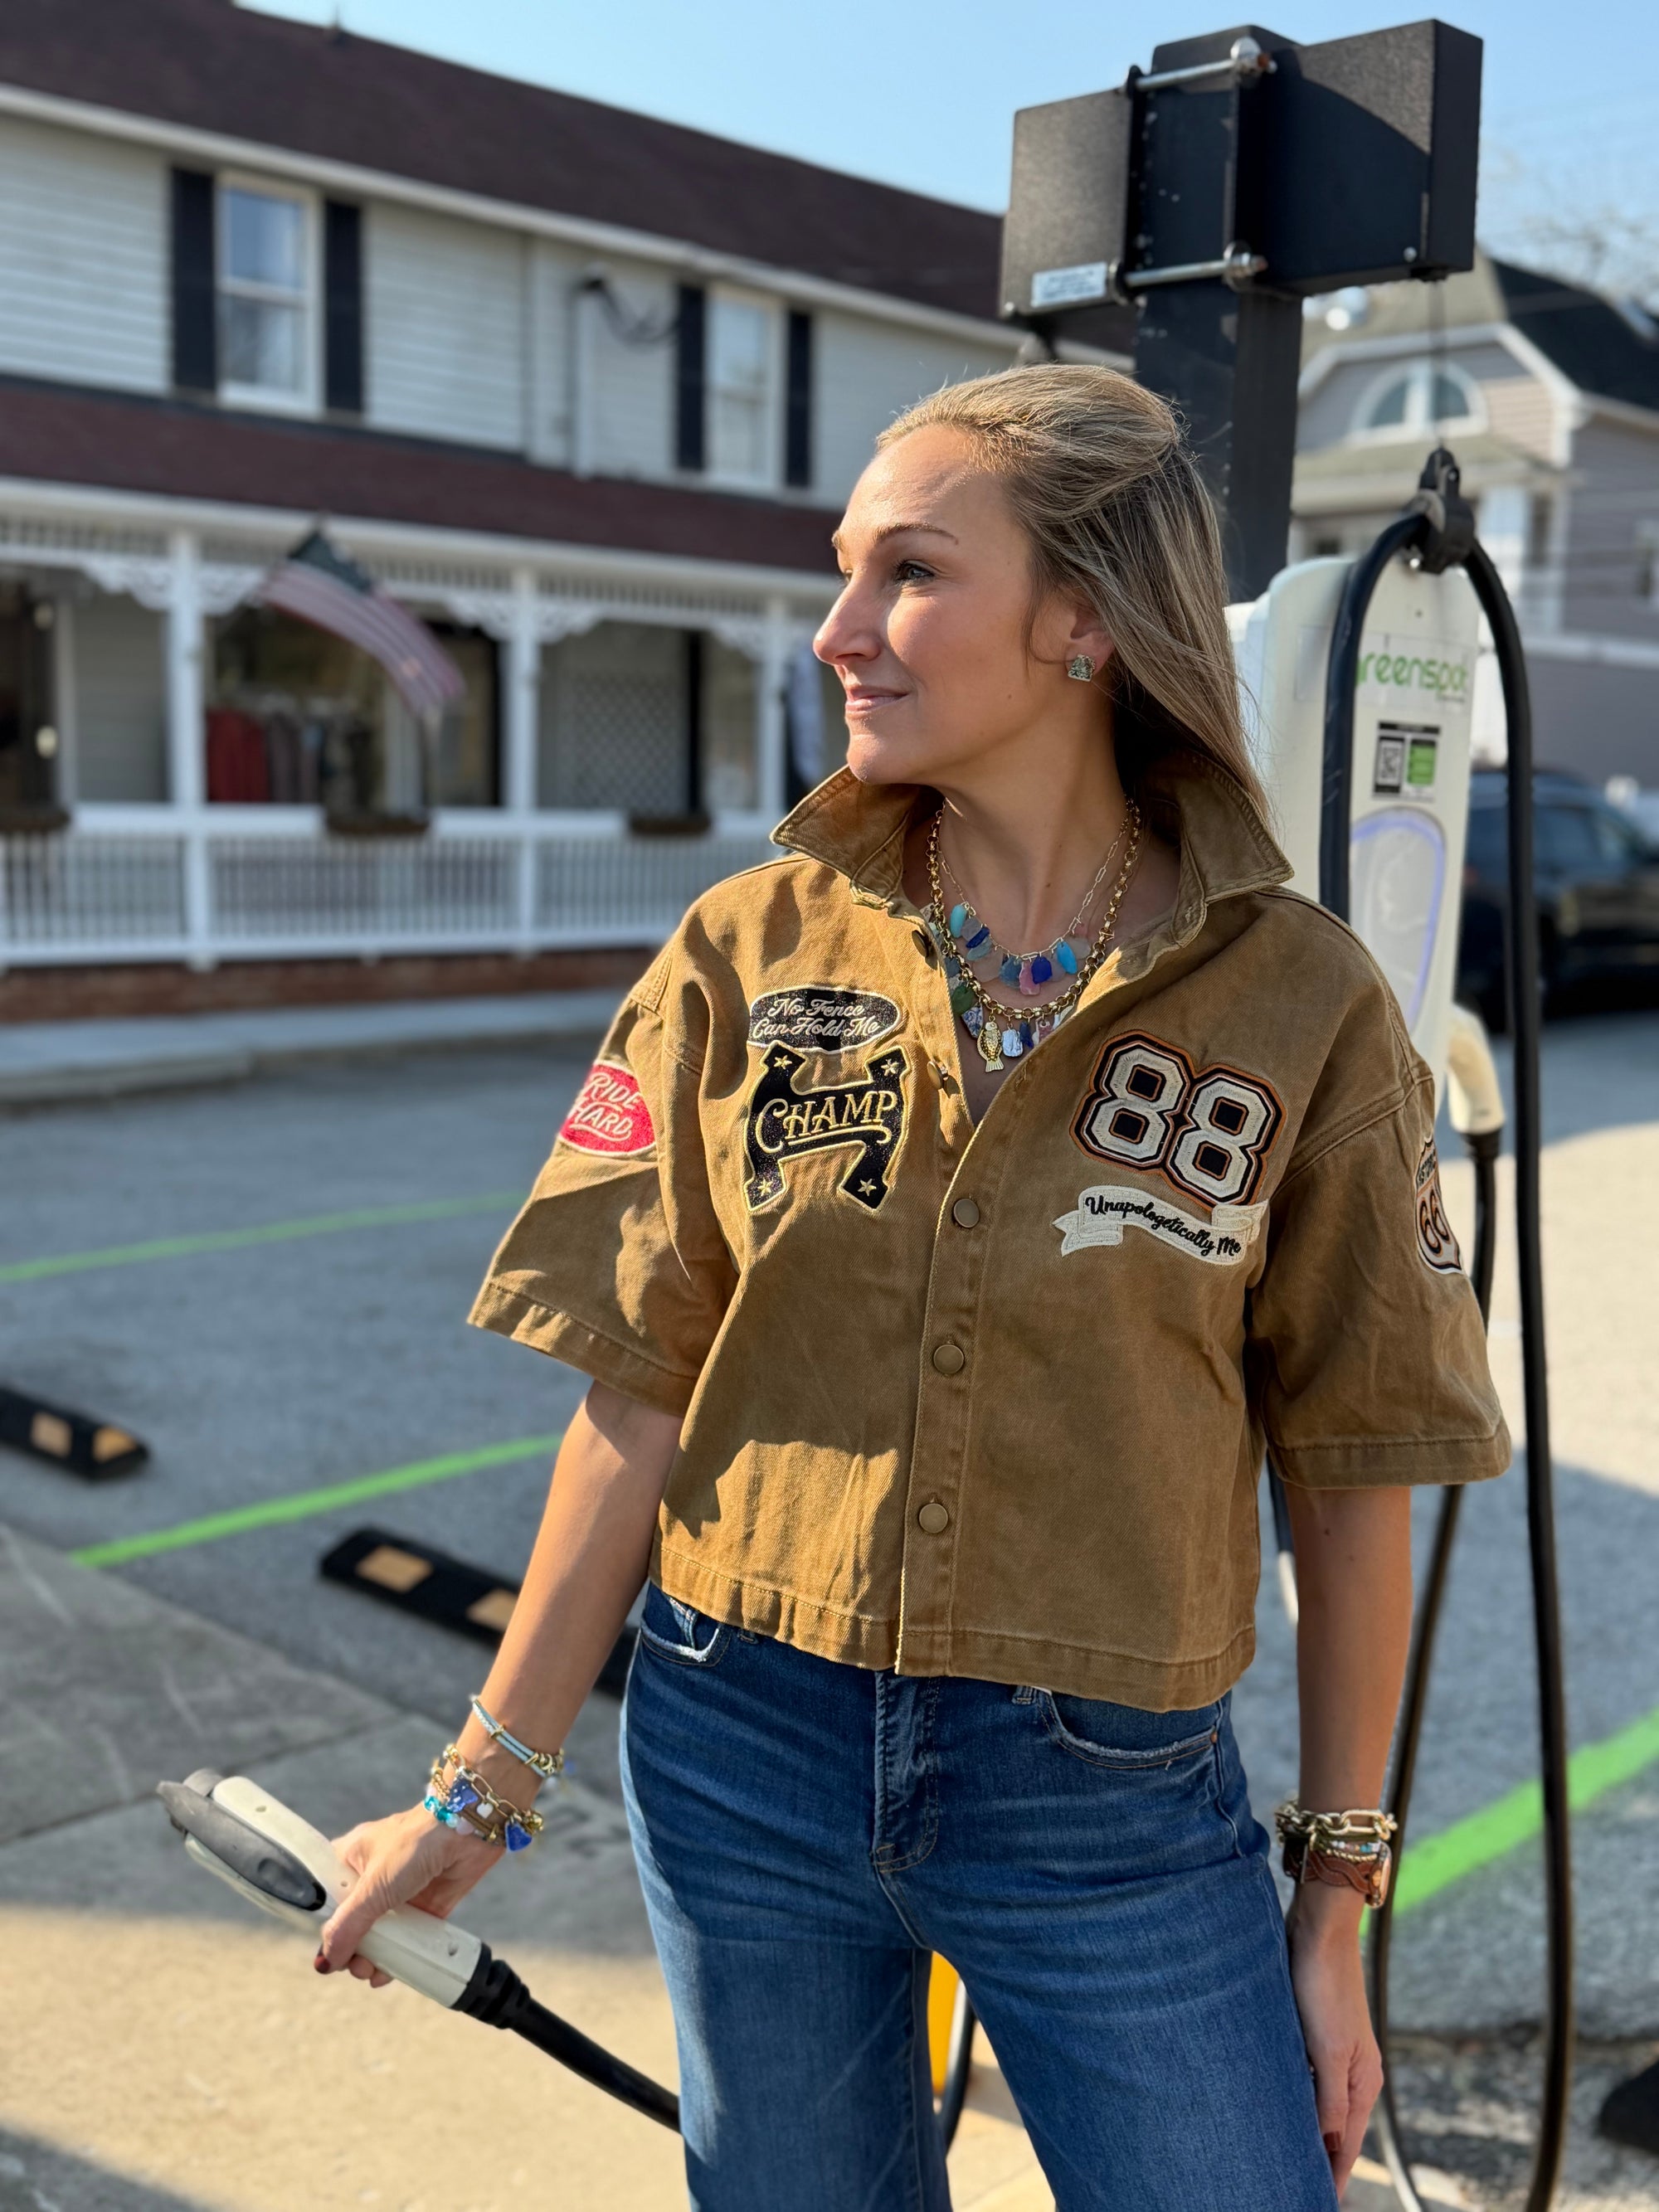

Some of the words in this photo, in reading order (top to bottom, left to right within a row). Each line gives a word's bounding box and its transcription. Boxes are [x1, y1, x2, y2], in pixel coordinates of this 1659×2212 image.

[1355, 651, 1468, 697] reenspot
[752, 1018, 791, 1038] Can
[790, 1017, 846, 1037] Hold
[844, 1016, 881, 1037] Me
[767, 998, 805, 1017] No
[806, 999, 865, 1017] Fence
[581, 1072, 642, 1111] RIDE
[567, 1096, 634, 1135] HARD
[755, 1091, 898, 1154] CHAMP
[1080, 1038, 1279, 1205] 88
[1085, 1195, 1216, 1257] Unapologetically
[1216, 1236, 1243, 1257] Me
[1419, 1187, 1451, 1256] 66
